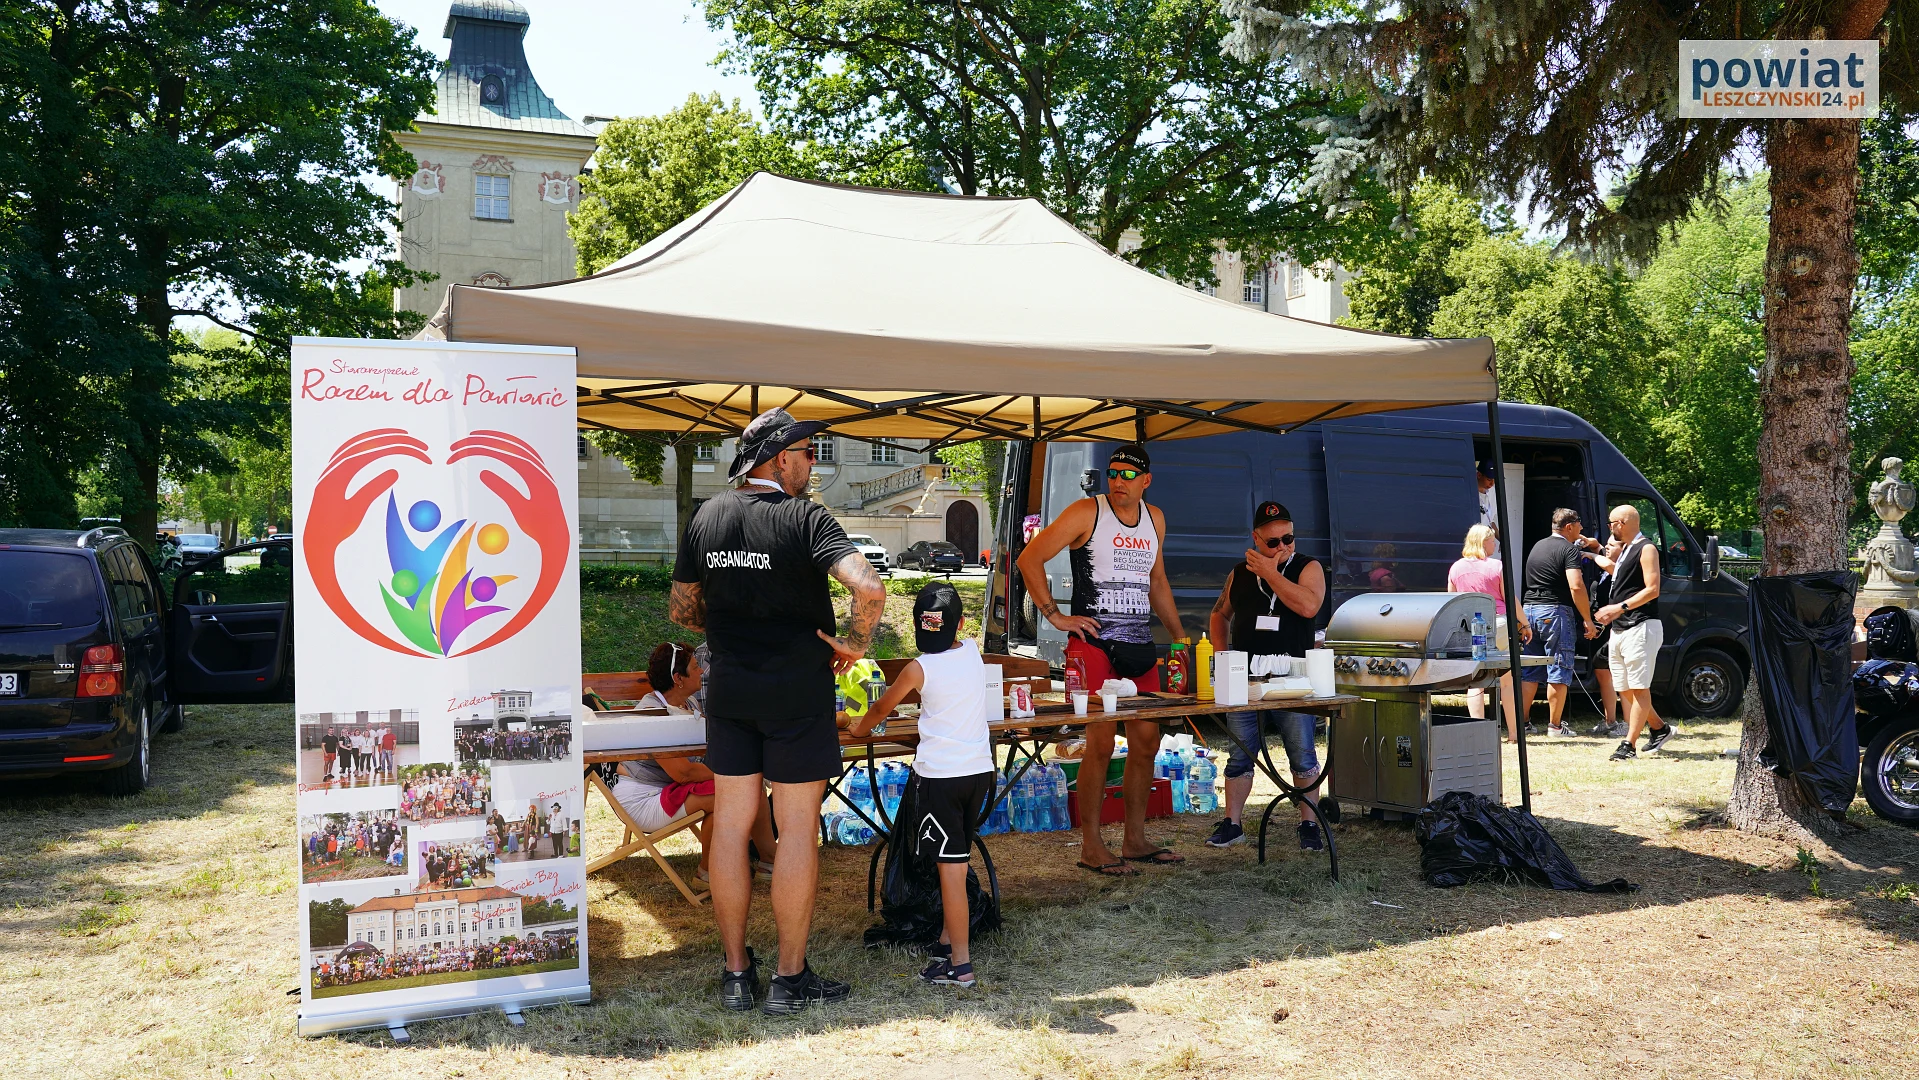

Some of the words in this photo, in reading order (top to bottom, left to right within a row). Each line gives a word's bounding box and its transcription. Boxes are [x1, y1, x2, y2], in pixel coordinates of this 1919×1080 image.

[329, 358, 420, 384] Stowarzyszenie
[301, 368, 395, 402] Razem
[402, 378, 454, 405] dla
[1112, 532, 1151, 550] ÓSMY
[706, 550, 772, 570] ORGANIZATOR
[0, 675, 15, 690] 3
